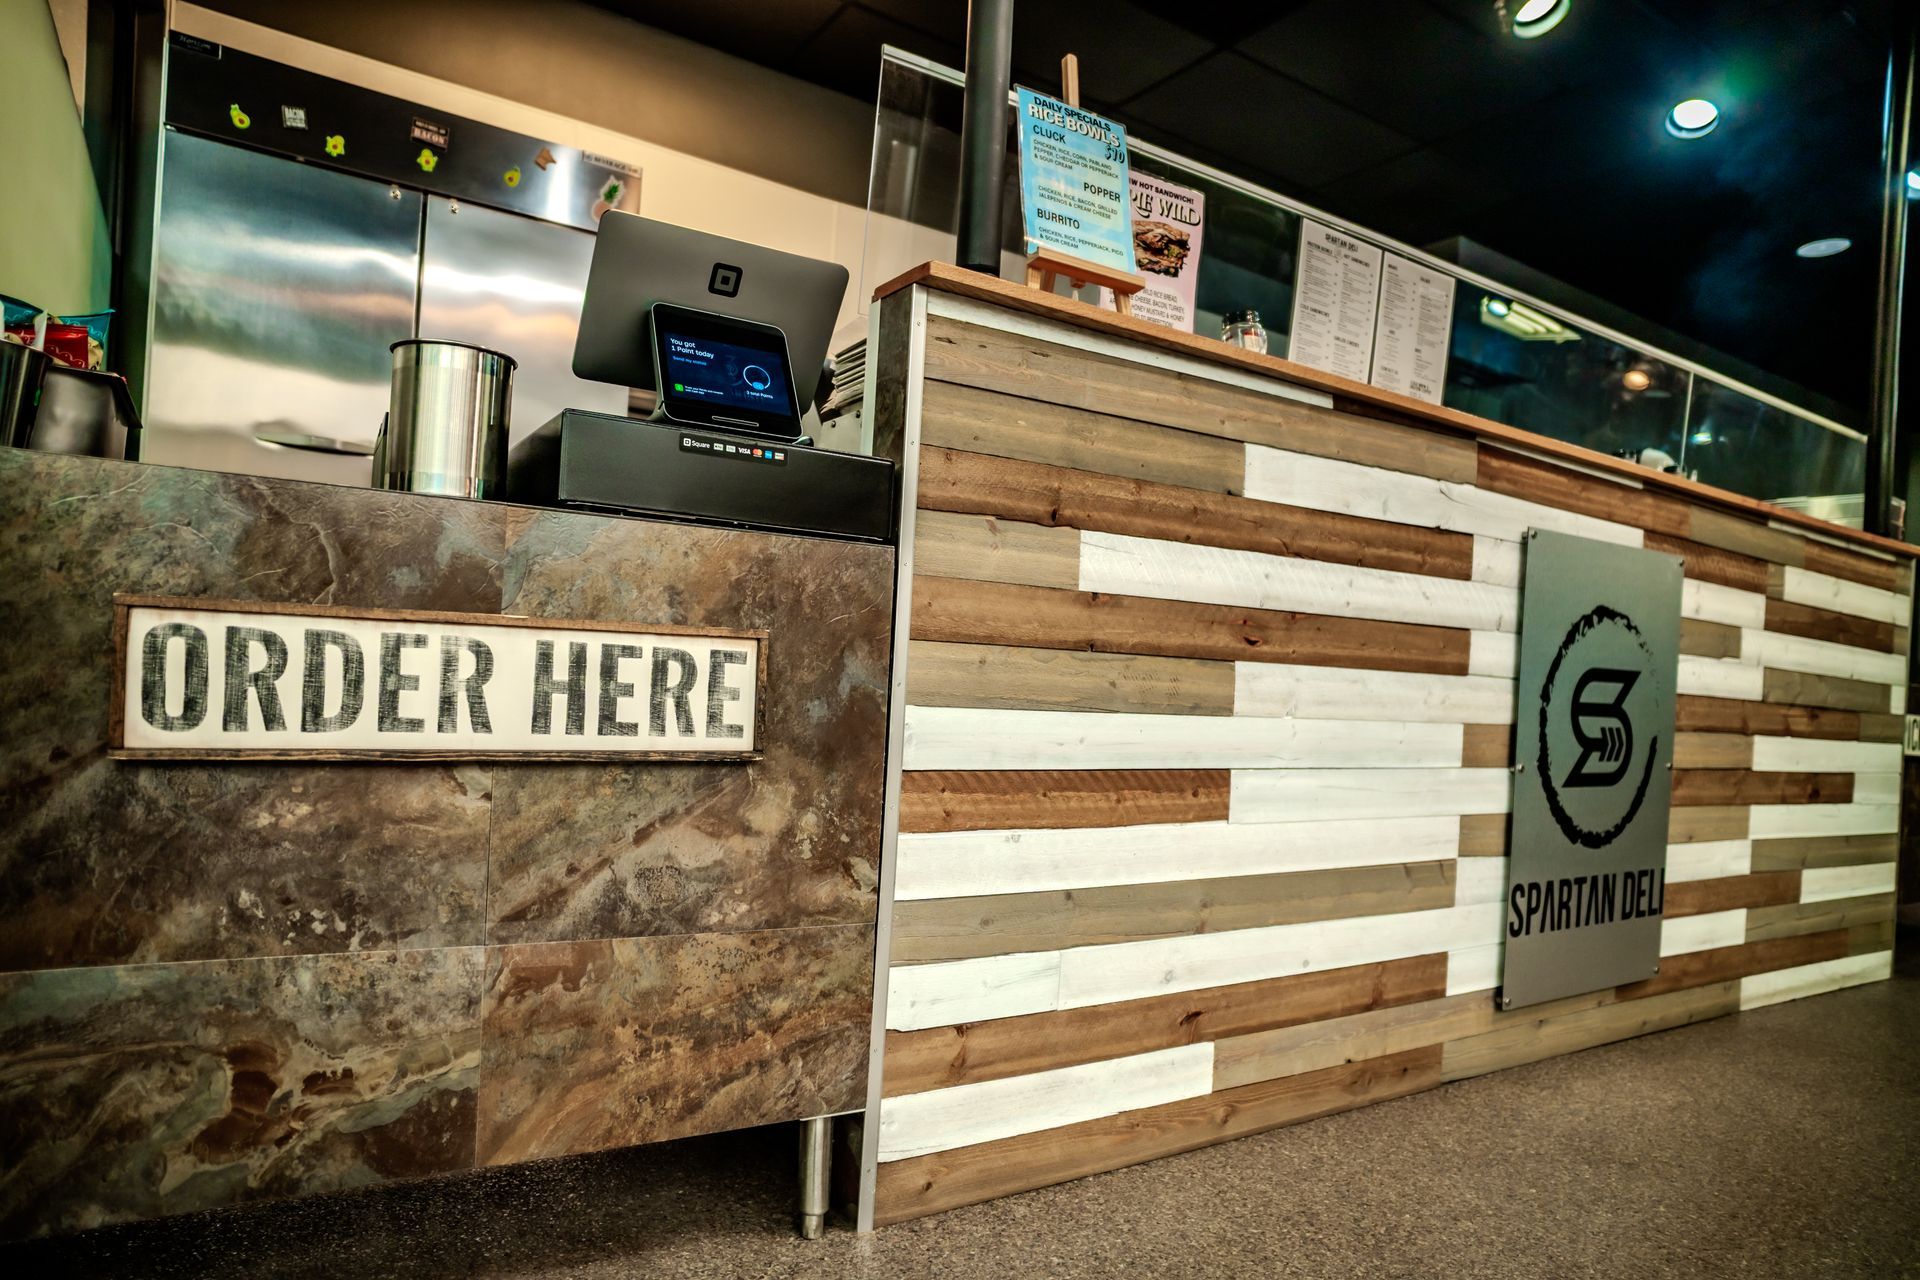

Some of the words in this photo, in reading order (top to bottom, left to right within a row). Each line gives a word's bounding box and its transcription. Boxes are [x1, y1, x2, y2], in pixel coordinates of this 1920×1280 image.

[1034, 96, 1062, 112] DAILY
[1064, 108, 1111, 132] SPECIALS
[1028, 103, 1065, 128] RICE
[1066, 116, 1120, 148] BOWLS
[1033, 125, 1066, 144] CLUCK
[1040, 155, 1053, 164] SOUR
[1055, 159, 1073, 170] CREAM
[1105, 144, 1125, 164] $10
[1056, 153, 1080, 165] CHEDDAR
[1089, 164, 1119, 179] PEPPERJACK
[1084, 182, 1121, 203] POPPER
[1139, 181, 1154, 191] HOT
[1155, 187, 1194, 205] SANDWICH!
[1037, 208, 1080, 230] BURRITO
[1074, 203, 1092, 213] CREAM
[1093, 209, 1111, 220] CHEESE
[1098, 204, 1118, 215] GRILLED
[1158, 198, 1201, 226] WILD
[1045, 235, 1060, 244] SOUR
[1060, 240, 1078, 249] CREAM
[1154, 290, 1163, 298] RICE
[1146, 308, 1166, 317] MUSTARD
[670, 338, 682, 346] You
[677, 346, 694, 355] Point
[696, 350, 714, 359] today
[692, 440, 710, 449] Square
[738, 447, 751, 455] VISA
[141, 622, 494, 734] ORDER
[531, 639, 751, 738] HERE
[1508, 872, 1617, 938] SPARTAN
[1621, 868, 1665, 920] DELI
